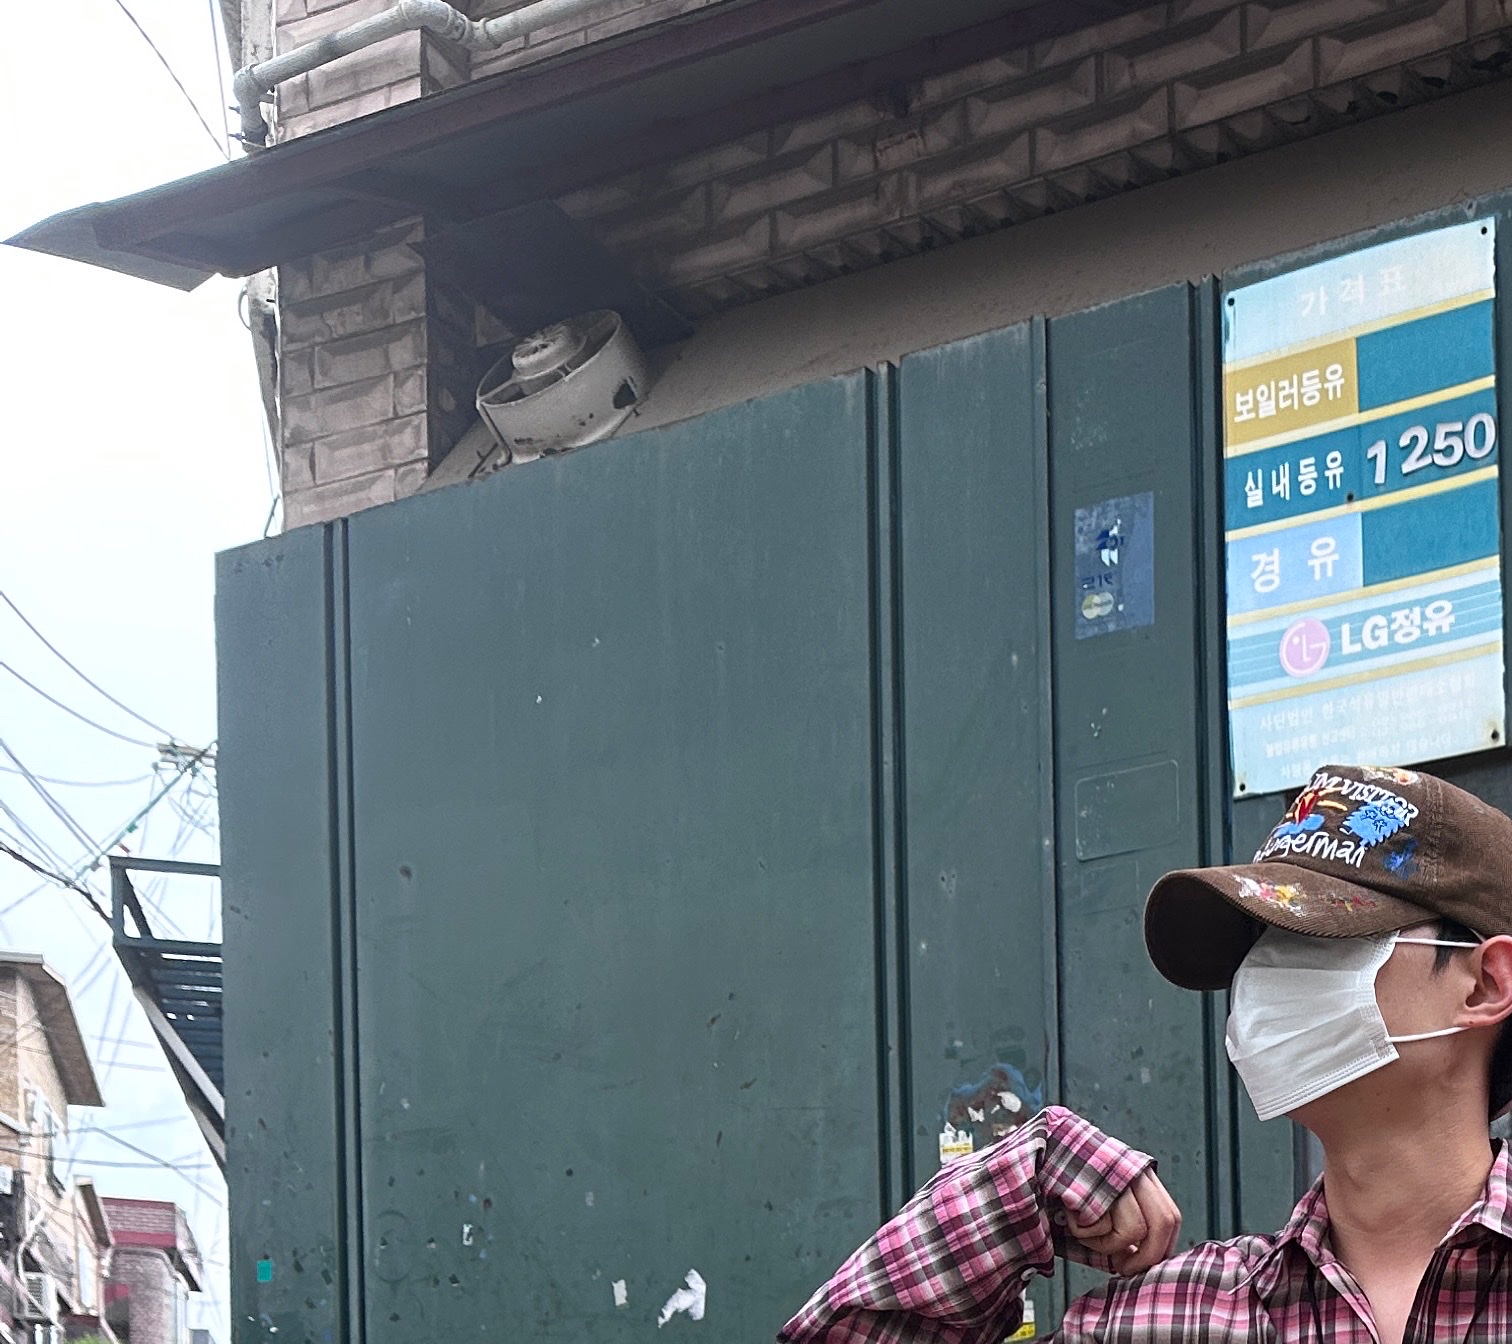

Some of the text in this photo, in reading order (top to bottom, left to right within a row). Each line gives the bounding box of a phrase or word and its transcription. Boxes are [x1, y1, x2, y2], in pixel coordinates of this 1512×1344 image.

[1233, 363, 1345, 423] 보일러등유
[1244, 412, 1496, 509] 실내등유 1250
[1340, 599, 1456, 655] LG정유
